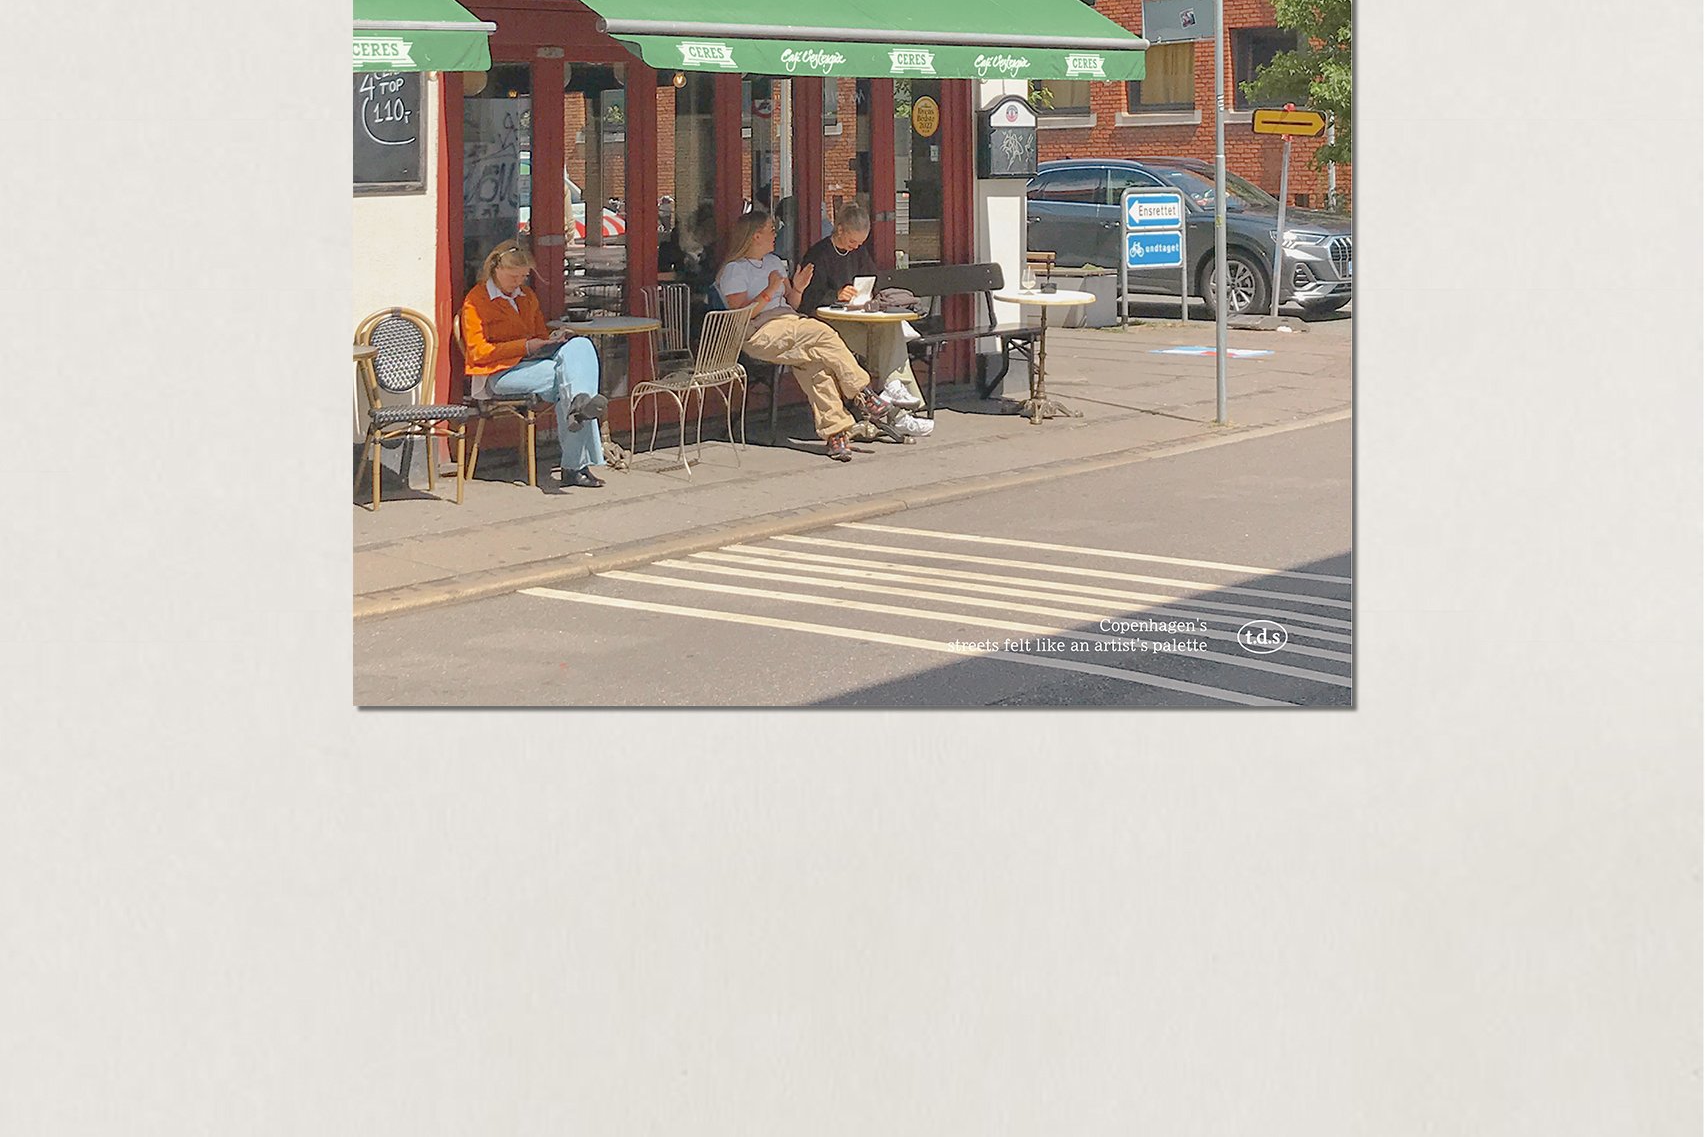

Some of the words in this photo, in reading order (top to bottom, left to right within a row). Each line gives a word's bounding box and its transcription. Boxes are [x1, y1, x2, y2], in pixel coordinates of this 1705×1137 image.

[353, 43, 399, 56] CERES
[688, 46, 725, 59] CERES
[897, 53, 927, 65] CERES
[1072, 57, 1098, 69] CERES
[359, 73, 376, 101] 4
[379, 78, 405, 95] TOP
[1138, 205, 1177, 217] Ensrettet
[1145, 243, 1180, 254] undtaget
